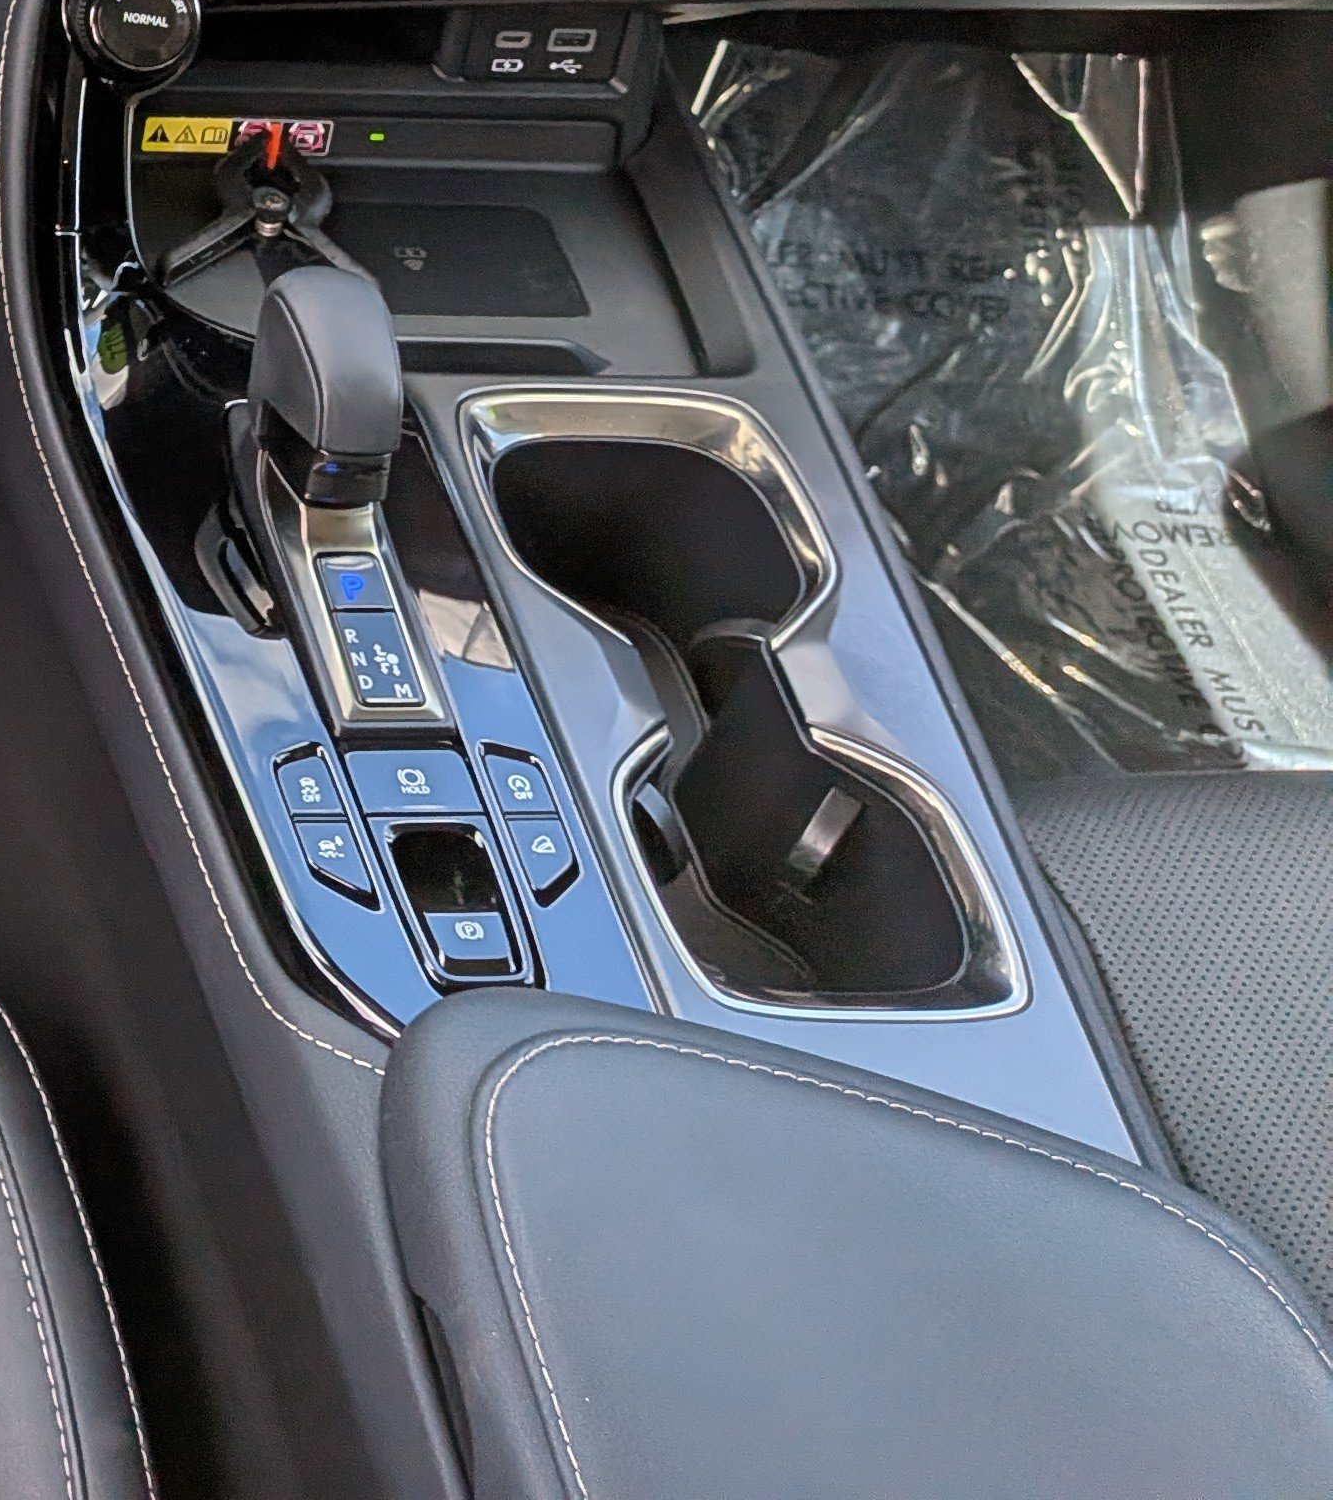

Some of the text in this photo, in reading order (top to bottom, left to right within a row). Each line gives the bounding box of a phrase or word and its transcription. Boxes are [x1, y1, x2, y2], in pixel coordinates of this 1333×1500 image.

[121, 10, 170, 29] NORMAL
[339, 572, 365, 602] P
[343, 627, 360, 644] R
[1136, 547, 1215, 651] DEALER
[1201, 665, 1267, 738] MUS
[349, 650, 369, 667] N
[357, 674, 374, 690] D
[393, 682, 414, 699] M
[400, 785, 431, 795] HOLD
